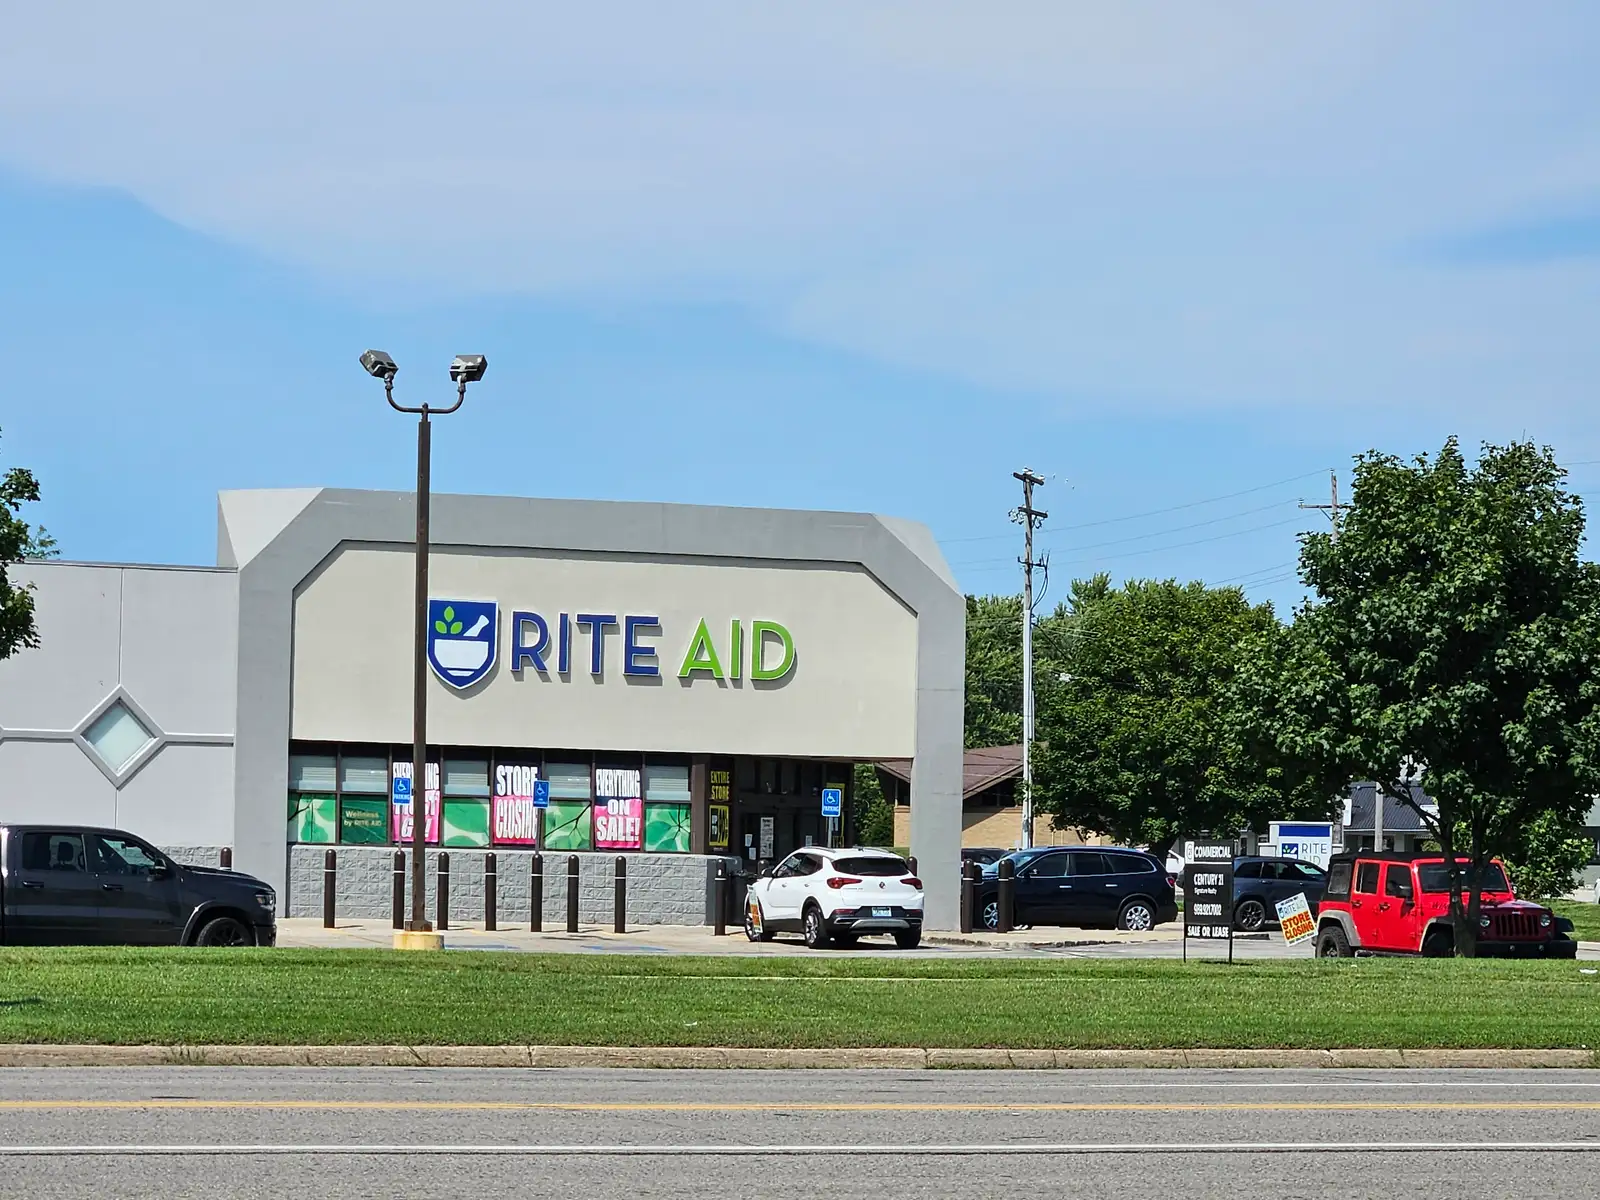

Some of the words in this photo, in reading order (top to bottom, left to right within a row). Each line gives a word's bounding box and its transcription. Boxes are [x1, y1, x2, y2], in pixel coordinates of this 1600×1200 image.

[510, 610, 661, 676] RITE
[677, 617, 796, 681] AID
[496, 764, 539, 797] STORE
[596, 768, 641, 797] EVERYTHING
[710, 771, 730, 784] ENTIRE
[711, 785, 730, 800] STORE
[607, 798, 631, 816] ON
[343, 819, 352, 827] by
[401, 816, 433, 839] G!
[495, 798, 538, 840] CLOSING
[596, 815, 641, 842] SALE!
[1194, 845, 1232, 858] COMMERCIAL
[1301, 842, 1328, 854] RITE
[1193, 873, 1218, 886] CENTURY
[1217, 873, 1225, 886] 21
[1284, 902, 1297, 914] RITE
[1281, 910, 1312, 931] STORE
[1187, 925, 1201, 937] SALE
[1201, 926, 1211, 937] OR
[1211, 926, 1229, 938] LEASE
[1284, 920, 1315, 940] CLOSING
